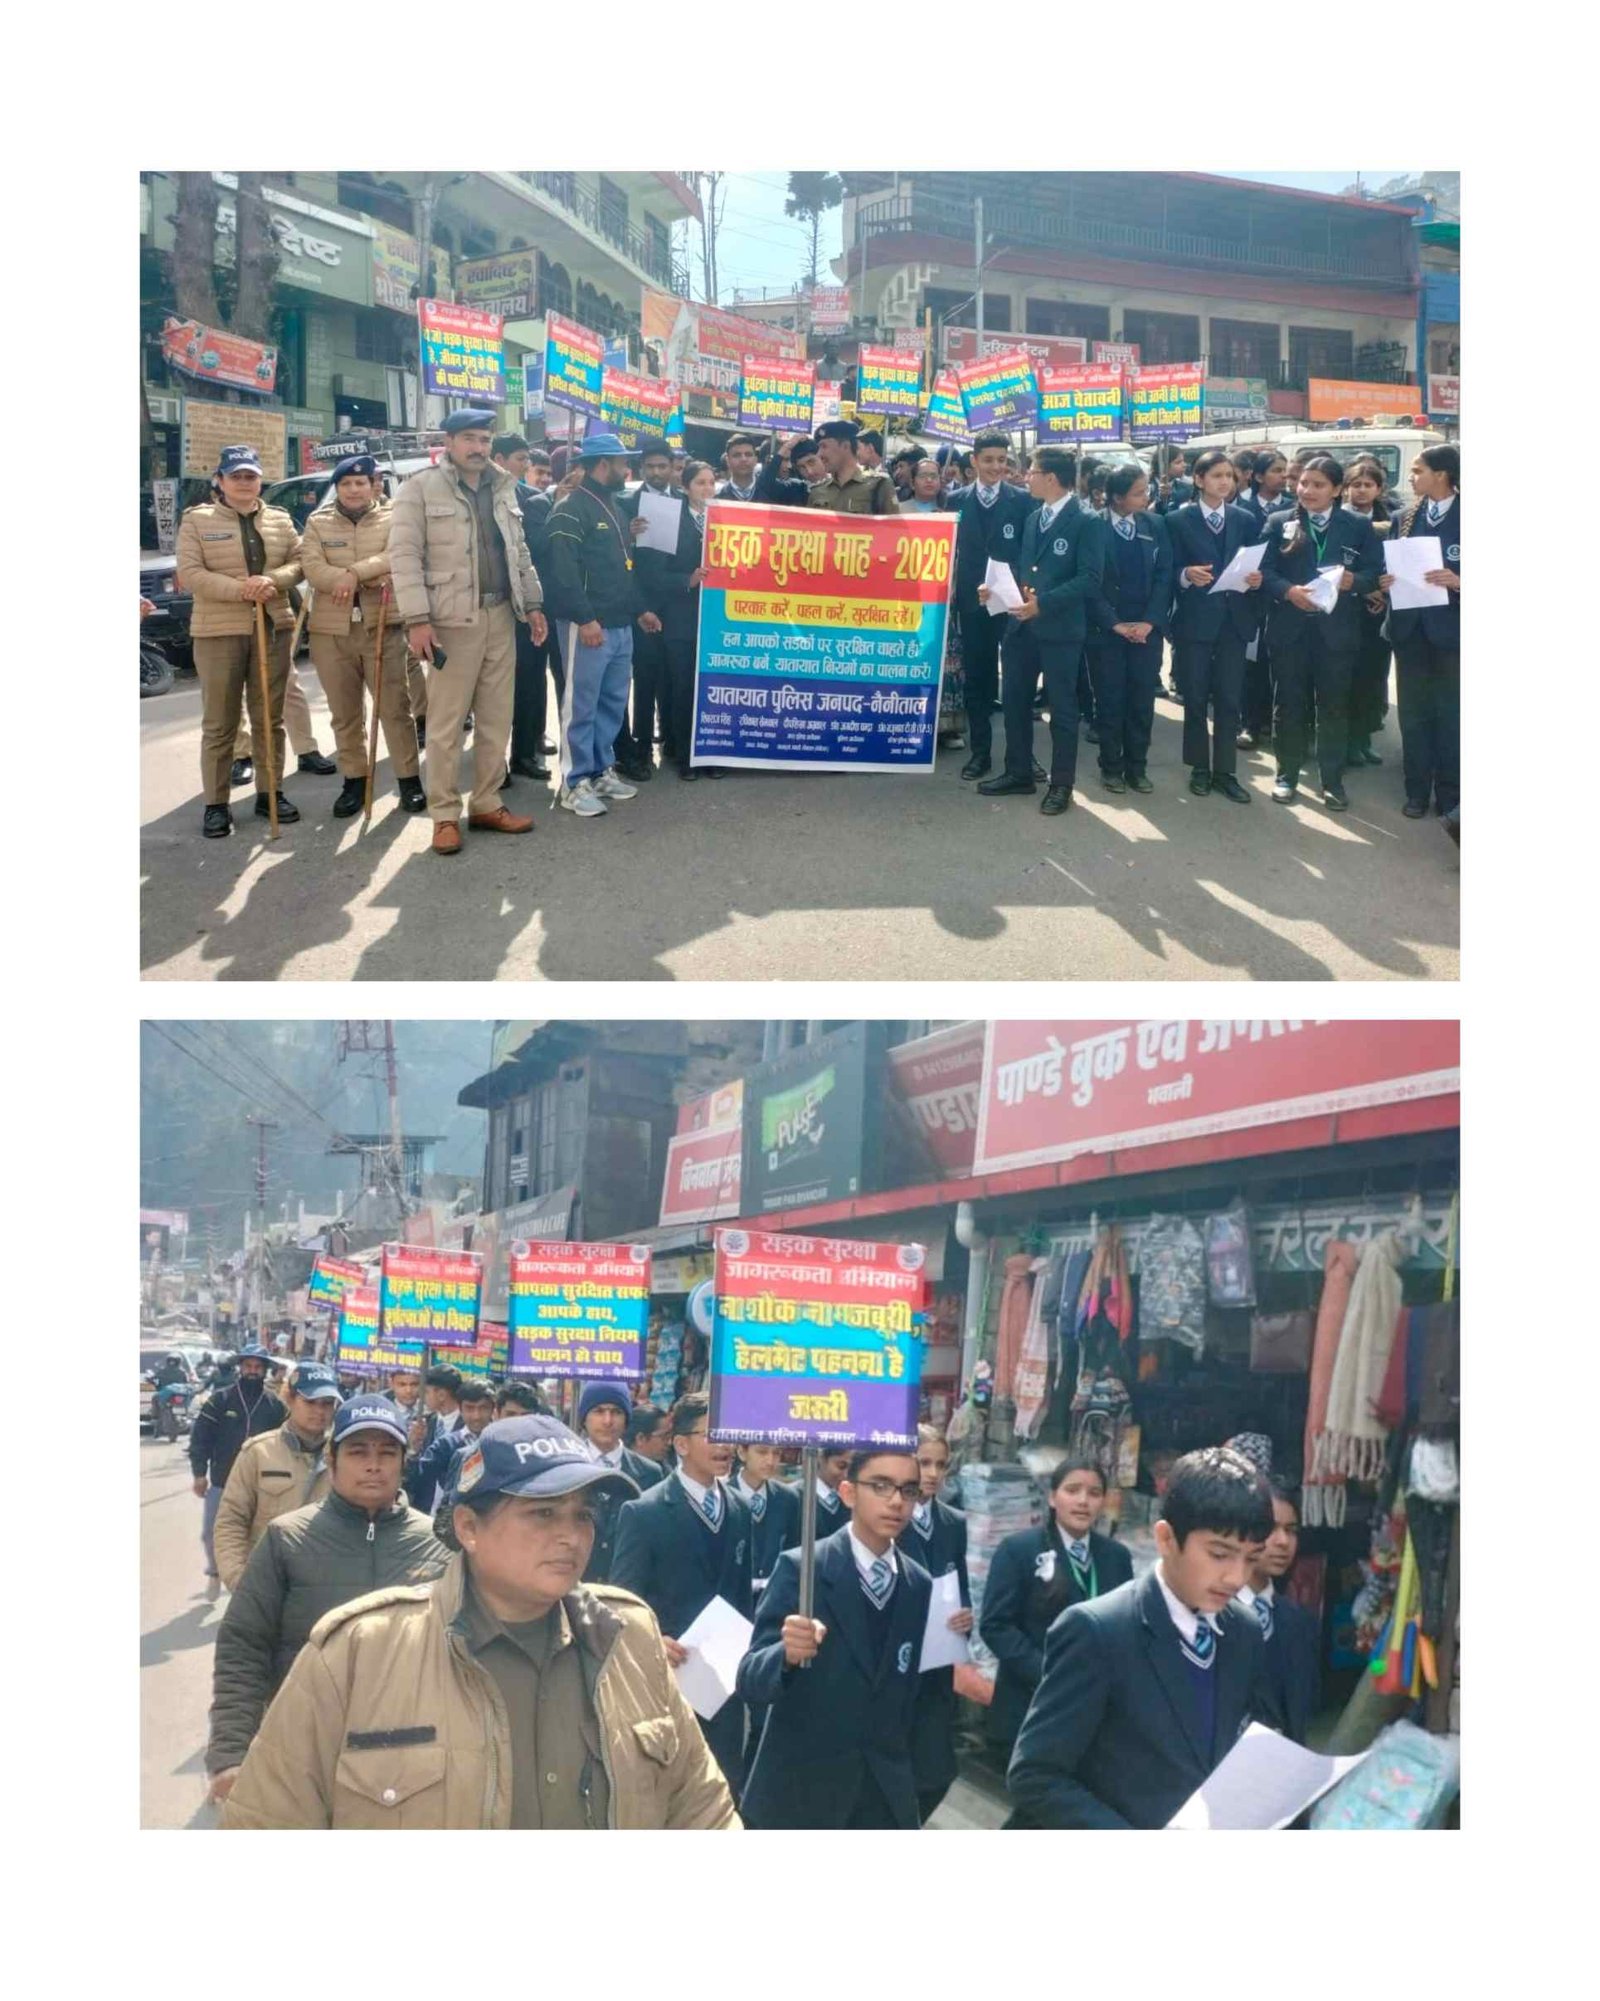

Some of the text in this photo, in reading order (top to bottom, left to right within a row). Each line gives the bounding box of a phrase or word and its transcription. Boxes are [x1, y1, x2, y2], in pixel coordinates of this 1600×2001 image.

[1042, 387, 1121, 410] आज चेतावनी
[1049, 415, 1074, 432] कल
[1076, 411, 1113, 431] जिन्दा
[708, 523, 765, 579] सड़क
[769, 528, 827, 586] सुरक्षा
[833, 532, 873, 579] माह
[895, 536, 950, 582] 2026
[734, 599, 767, 617] परवाह
[797, 603, 822, 620] पहल
[852, 606, 889, 627] सुरक्षित
[743, 632, 779, 649] आपको
[818, 639, 832, 653] पर
[835, 636, 874, 657] सुरक्षित
[877, 639, 905, 657] चाहते
[775, 657, 820, 675] यातायात
[822, 657, 857, 676] नियमों
[860, 664, 874, 677] का
[877, 665, 908, 679] पालन
[707, 684, 928, 715] यातायात पुलिस जनपद-नैनीताल
[996, 1036, 1066, 1108] पाण्डे
[1069, 1024, 1132, 1107] बुक
[1136, 1020, 1191, 1068] एव
[1147, 1072, 1194, 1105] भवाली
[538, 1244, 616, 1260] सड़क सुरक्षा
[762, 1234, 876, 1263] सड़क सुरक्षा
[725, 1260, 833, 1284] जागरूकता
[537, 1302, 582, 1319] आपके
[555, 1326, 596, 1344] सुरक्षा
[598, 1324, 640, 1343] नियम
[530, 1347, 572, 1362] पालन
[593, 1350, 623, 1365] साथ
[733, 1336, 905, 1378] हेलमेट पहनना है
[350, 1406, 397, 1421] POLICE
[709, 1427, 764, 1441] यातायात
[871, 1429, 918, 1446] नैनीताल
